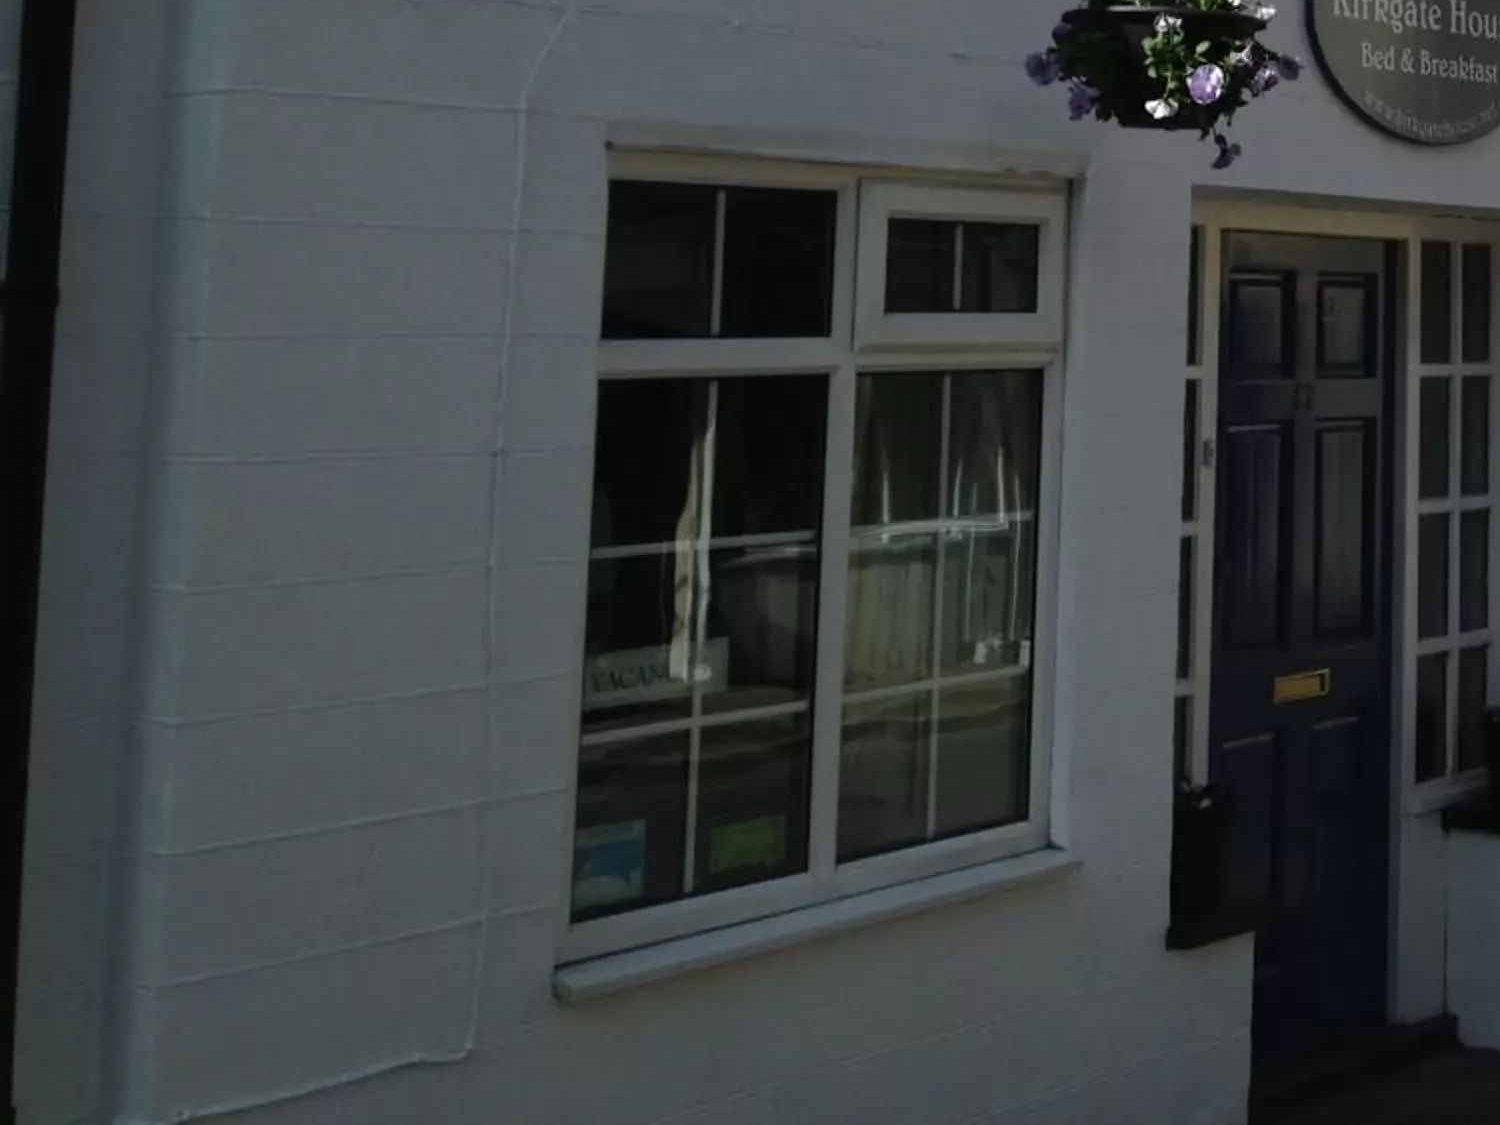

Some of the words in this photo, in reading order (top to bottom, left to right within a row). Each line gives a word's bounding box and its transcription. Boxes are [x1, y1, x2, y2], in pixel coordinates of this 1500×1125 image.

[1361, 42, 1395, 72] Bed
[1400, 48, 1415, 73] &
[1420, 51, 1499, 85] Breakfast
